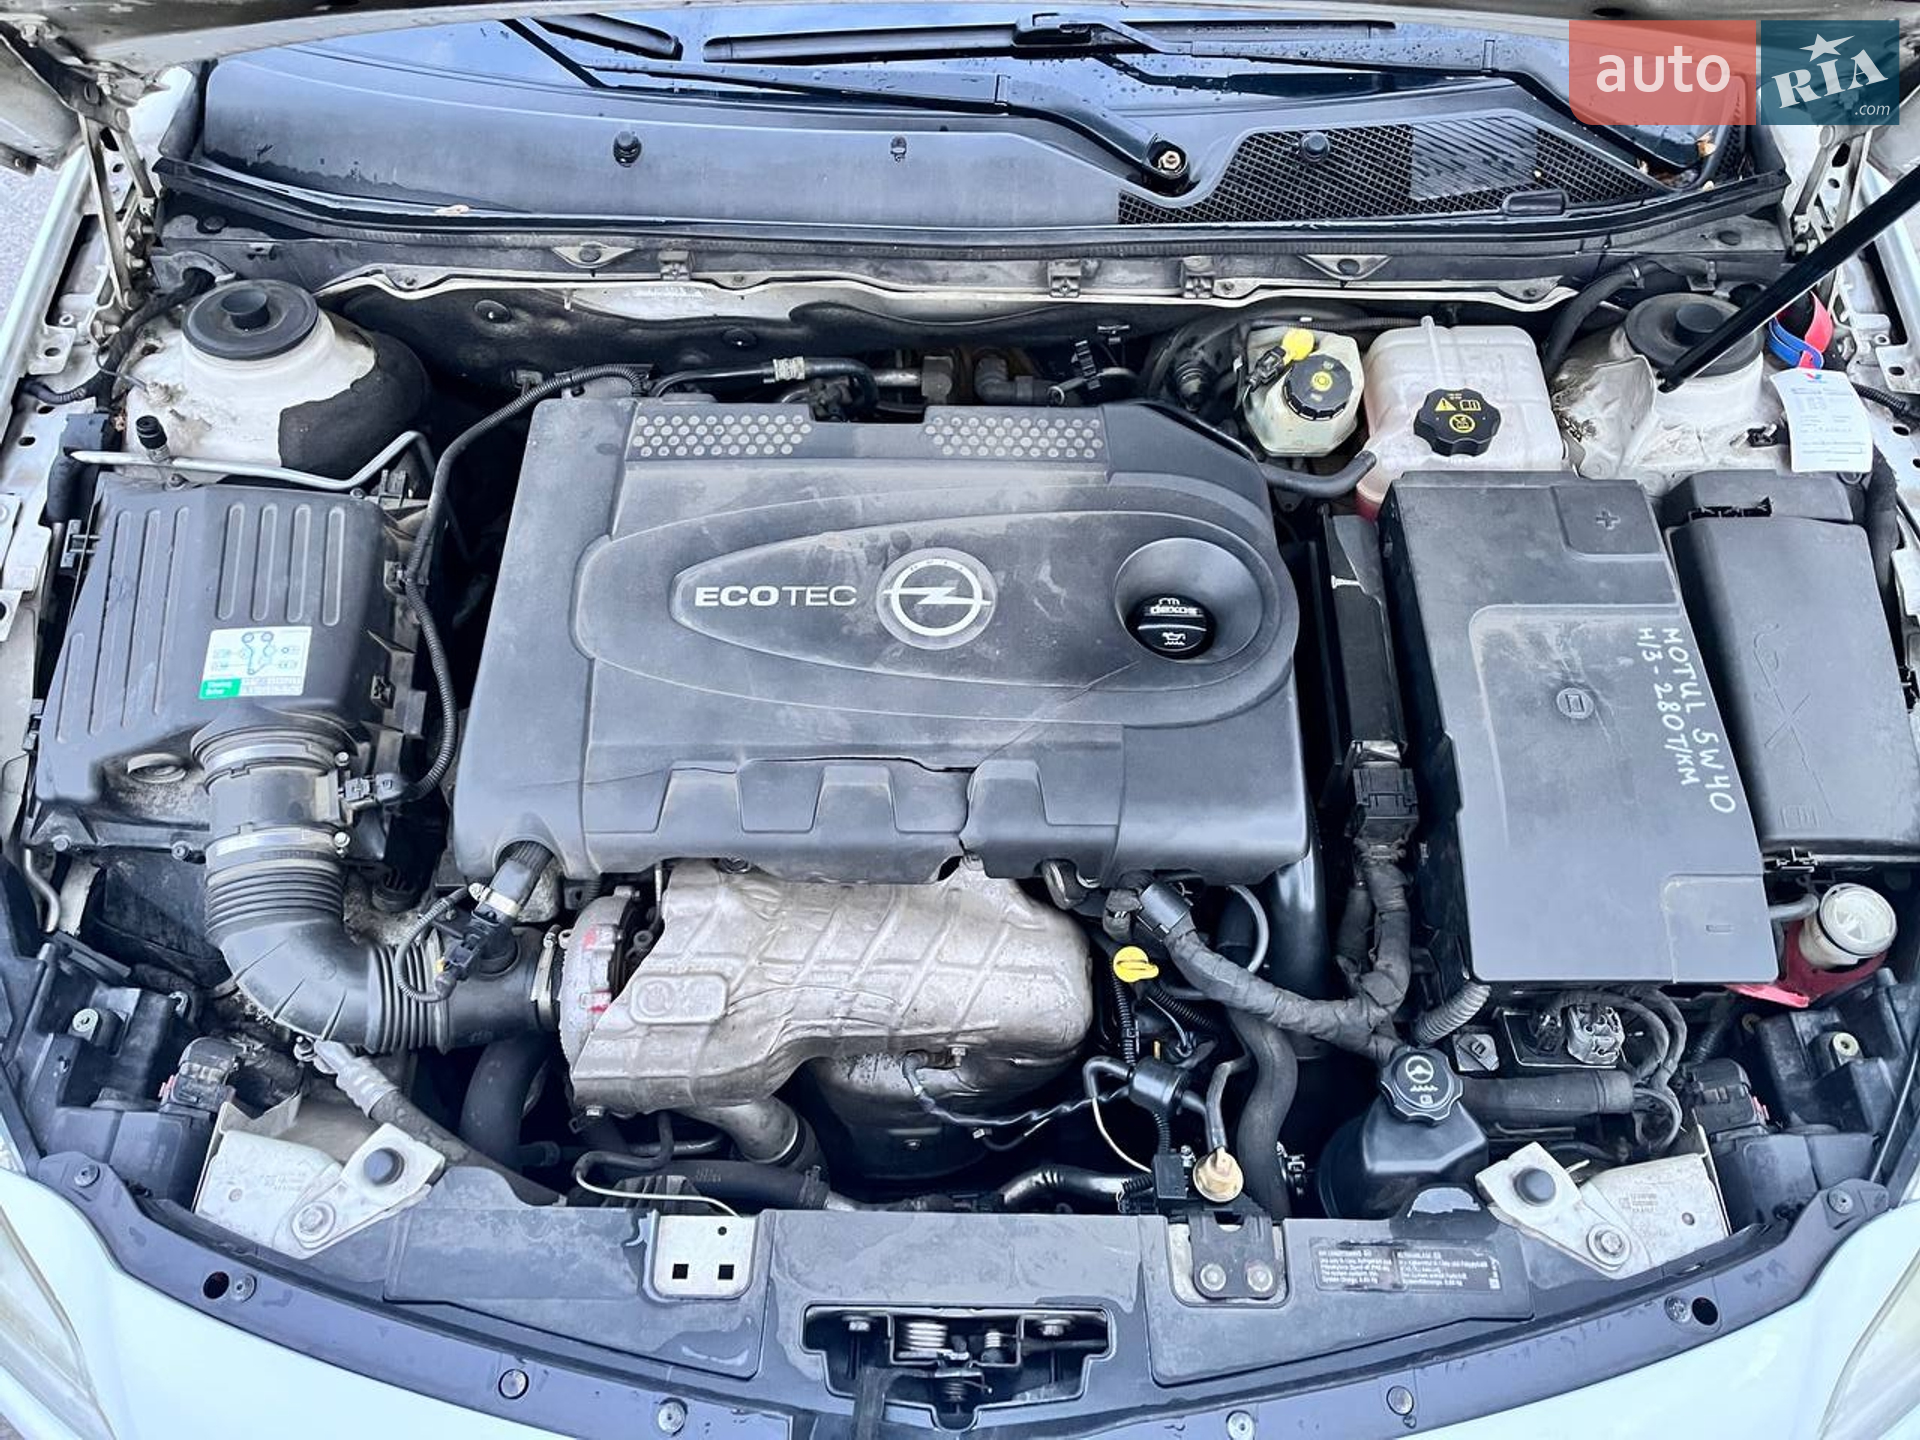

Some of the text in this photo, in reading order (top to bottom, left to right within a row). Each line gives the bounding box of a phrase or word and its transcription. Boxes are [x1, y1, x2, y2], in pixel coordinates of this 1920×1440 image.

[694, 585, 857, 607] ECOTEC
[1662, 628, 1736, 813] MOTUL 5W40
